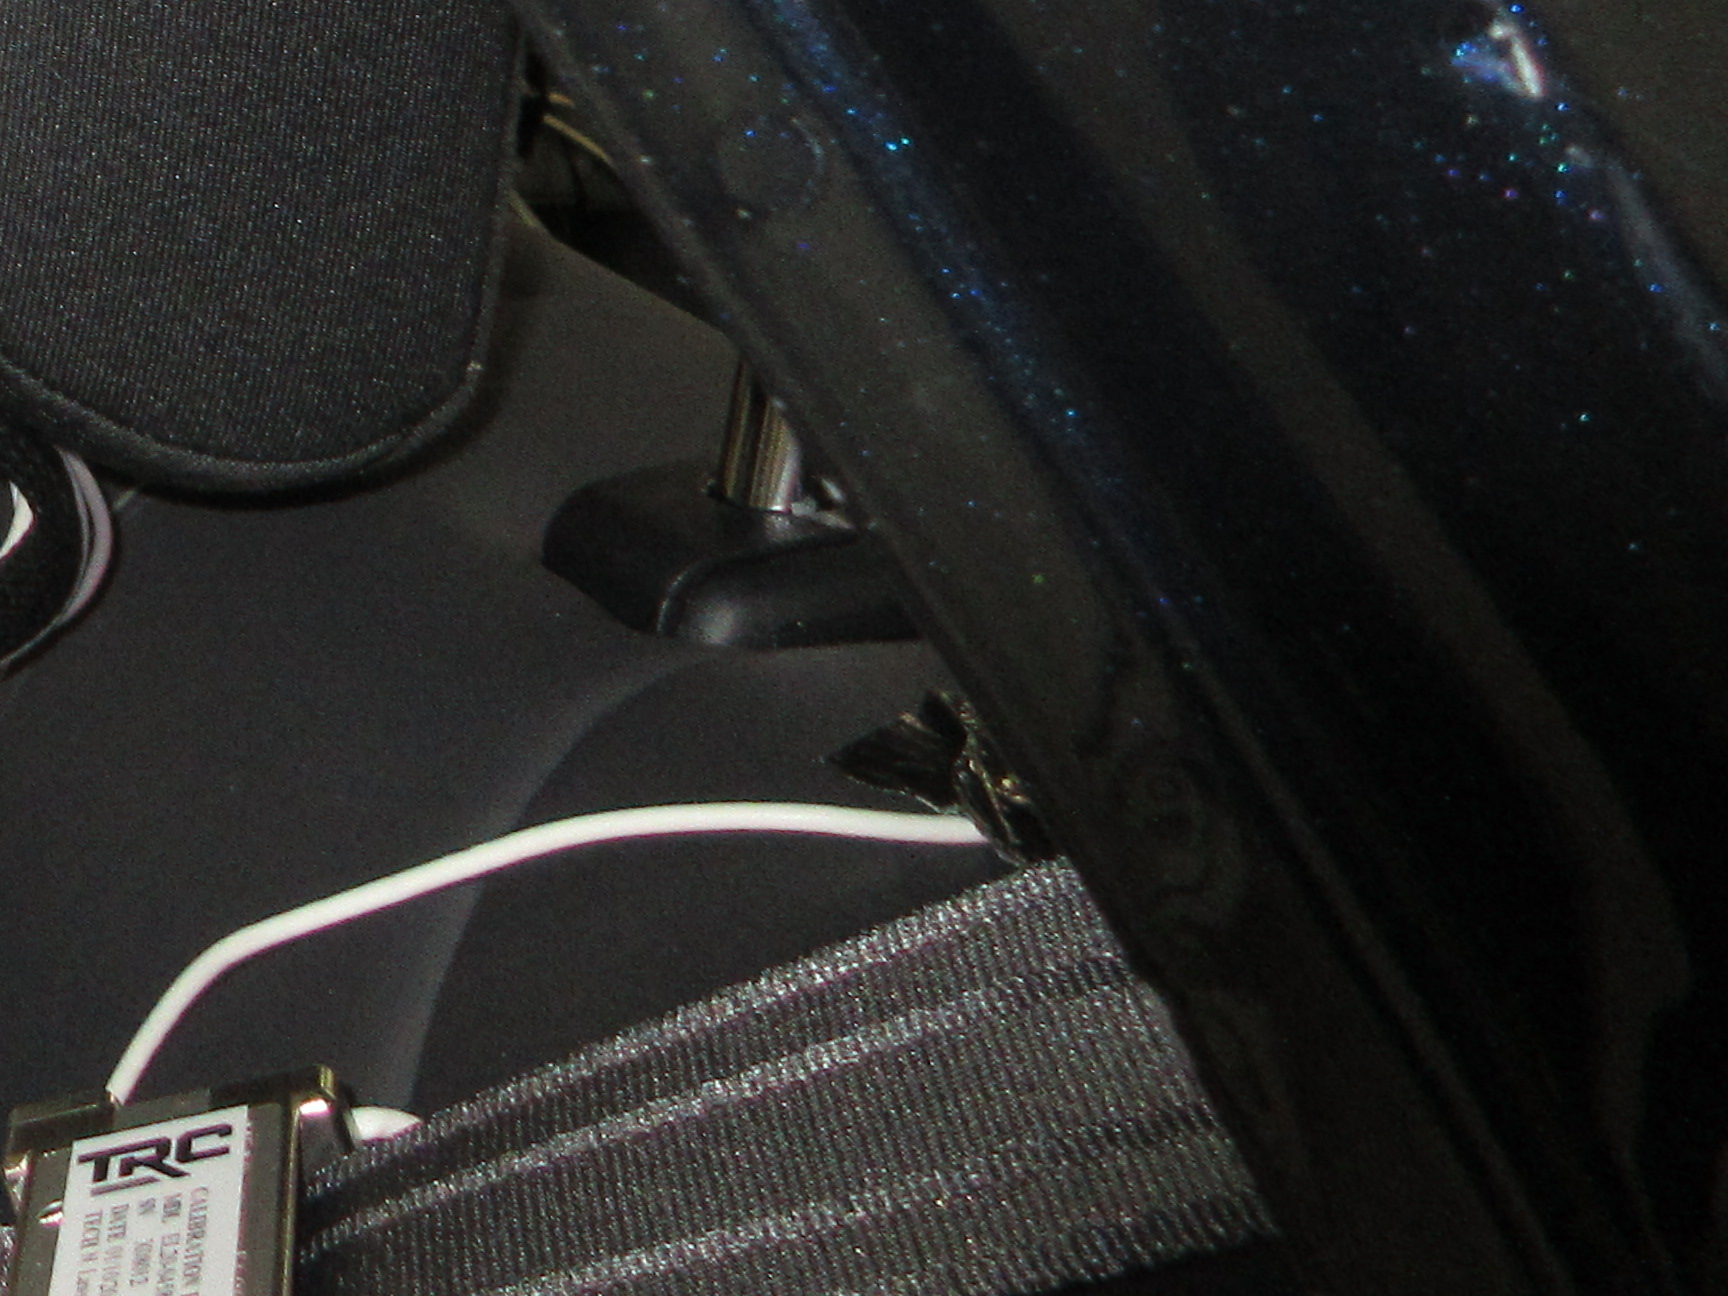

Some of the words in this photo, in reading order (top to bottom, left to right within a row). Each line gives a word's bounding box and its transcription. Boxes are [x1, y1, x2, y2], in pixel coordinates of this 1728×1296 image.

[77, 1123, 234, 1182] TRC
[81, 1209, 103, 1249] TECH
[107, 1204, 130, 1242] DATE
[183, 1187, 209, 1285] CALIBRATION
